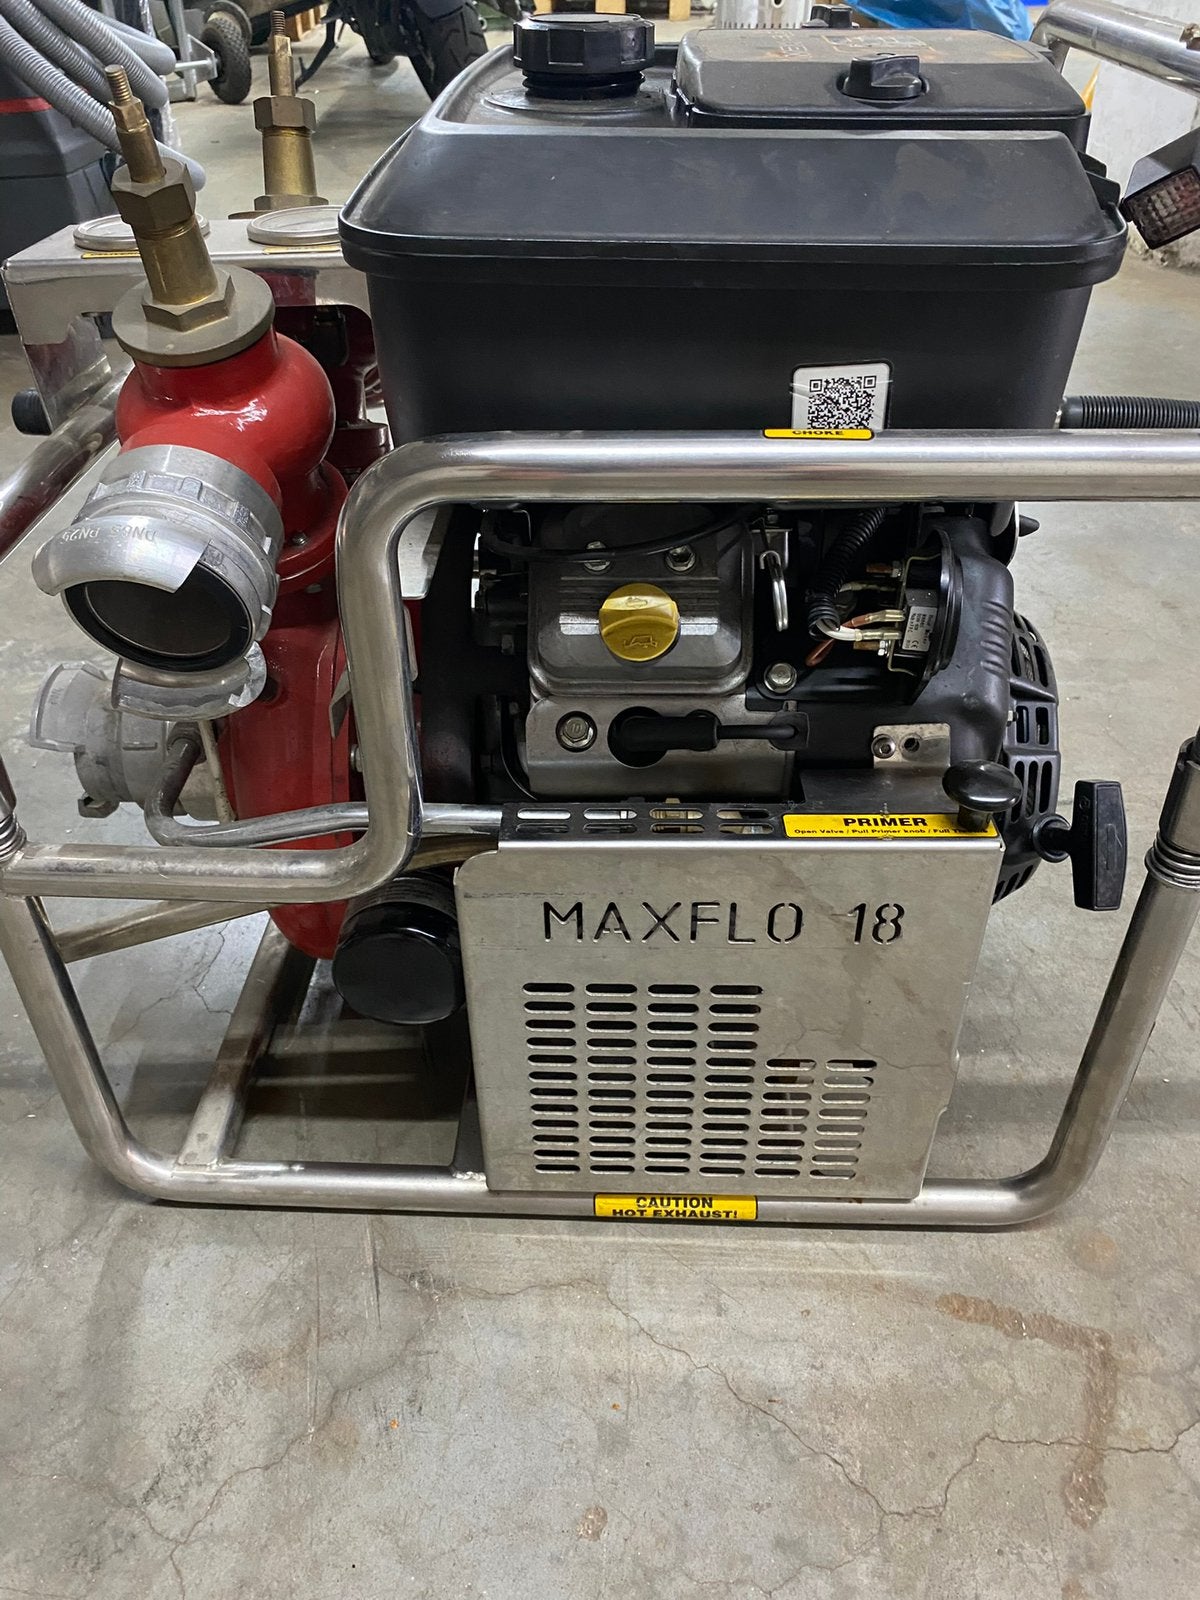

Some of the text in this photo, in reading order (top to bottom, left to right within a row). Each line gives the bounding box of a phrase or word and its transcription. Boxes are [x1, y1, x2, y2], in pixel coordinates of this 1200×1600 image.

[843, 817, 928, 827] PRIMER
[543, 902, 905, 945] MAXFLO 18
[635, 1196, 713, 1209] CAUTION
[612, 1209, 738, 1219] HOT EXHAUST!
